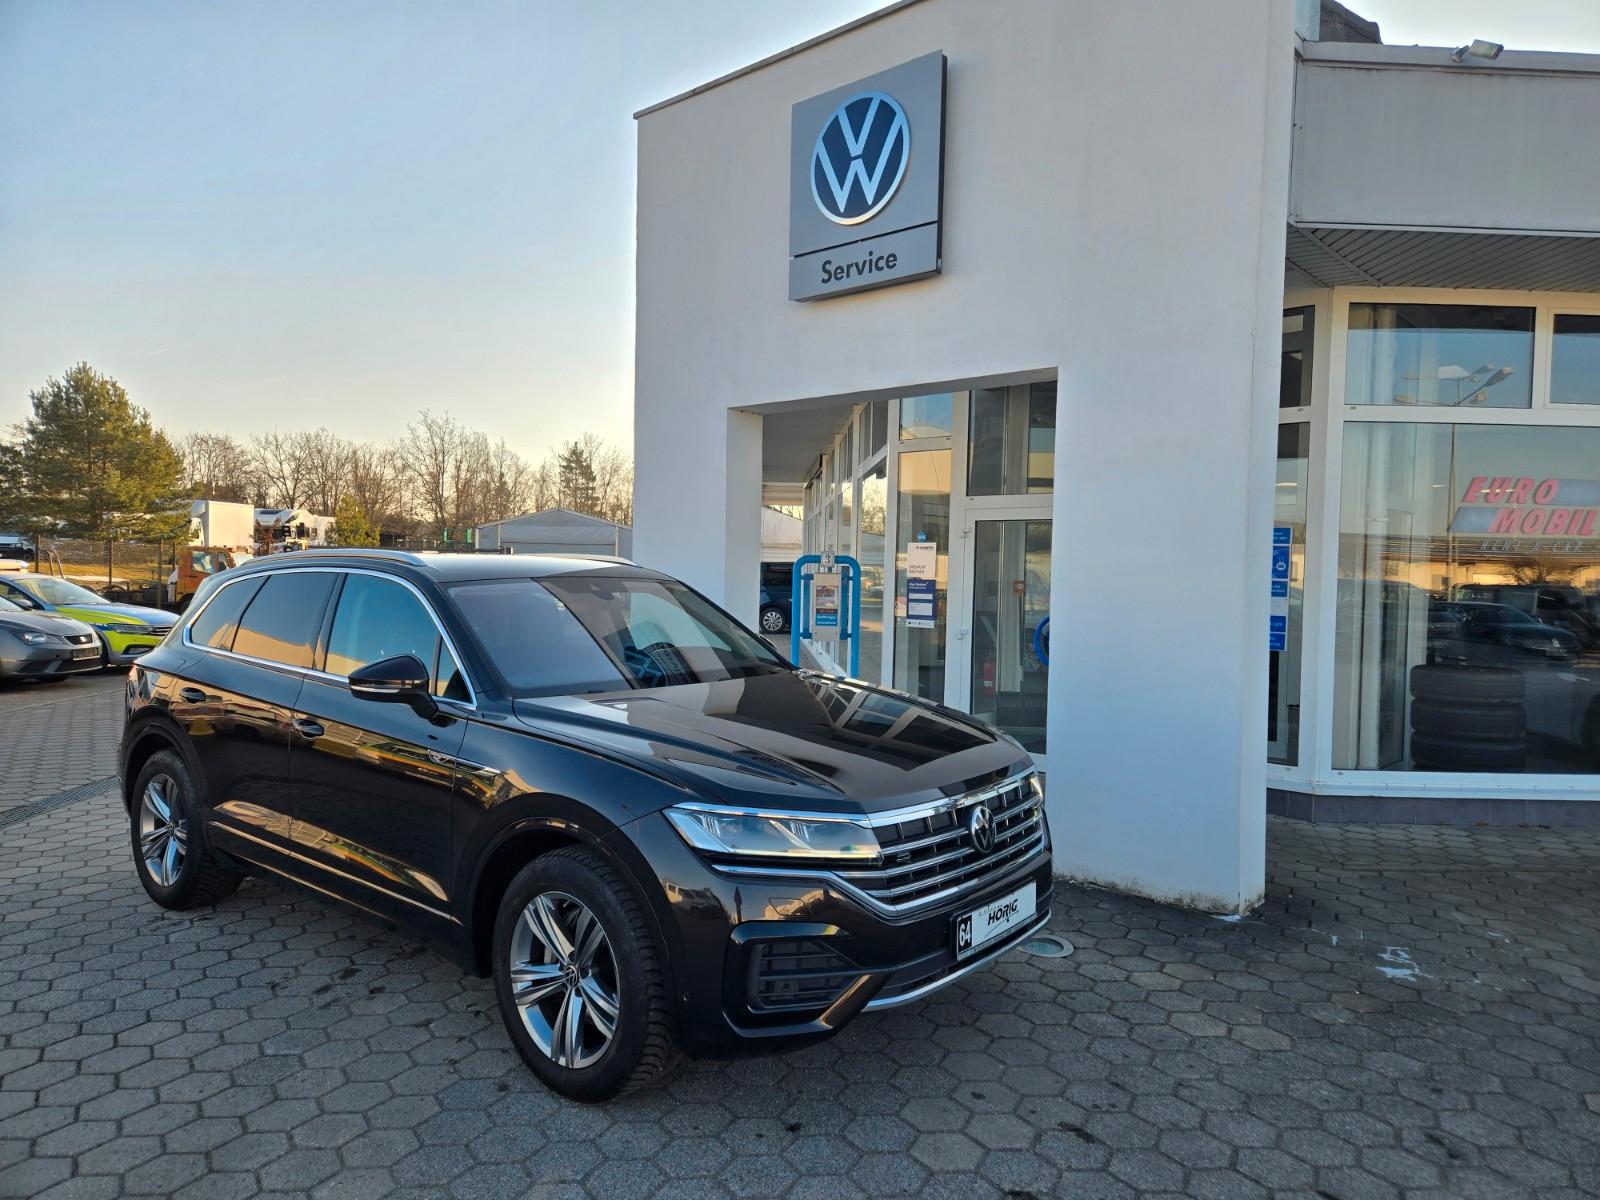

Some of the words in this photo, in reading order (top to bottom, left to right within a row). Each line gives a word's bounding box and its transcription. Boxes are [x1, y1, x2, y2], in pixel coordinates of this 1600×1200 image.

[820, 250, 898, 284] Service
[1462, 476, 1560, 505] EURO
[1487, 507, 1598, 537] MOBIL
[987, 898, 1019, 926] HÖRIG
[959, 919, 971, 947] 64
